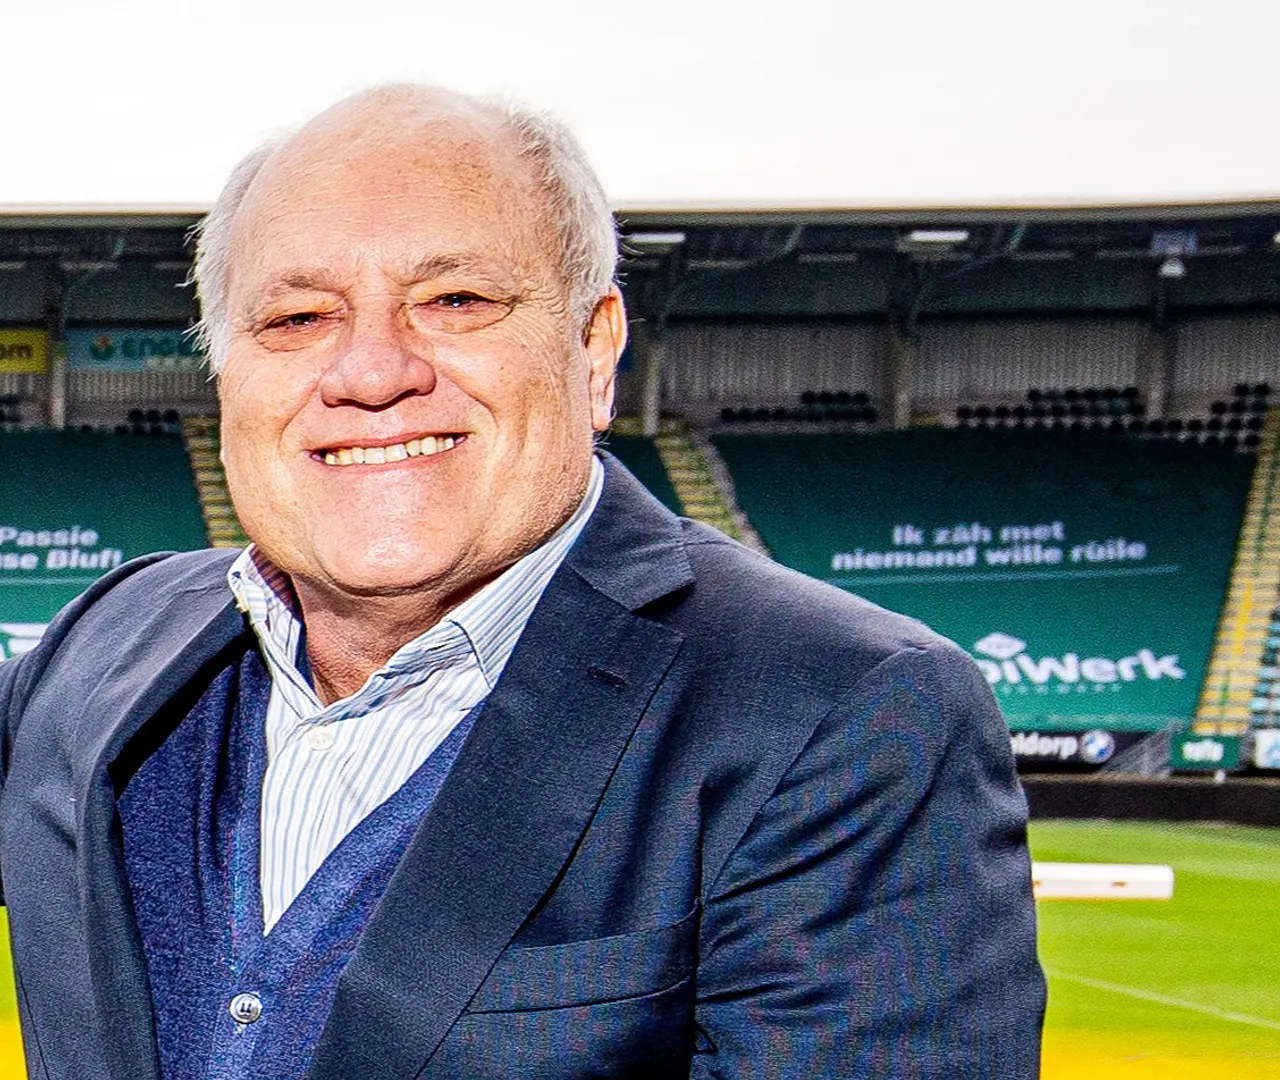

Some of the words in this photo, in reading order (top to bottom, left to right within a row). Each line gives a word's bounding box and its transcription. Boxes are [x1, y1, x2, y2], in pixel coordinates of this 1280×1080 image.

[1000, 519, 1065, 542] met
[831, 546, 977, 571] niemand
[985, 544, 1063, 566] wille
